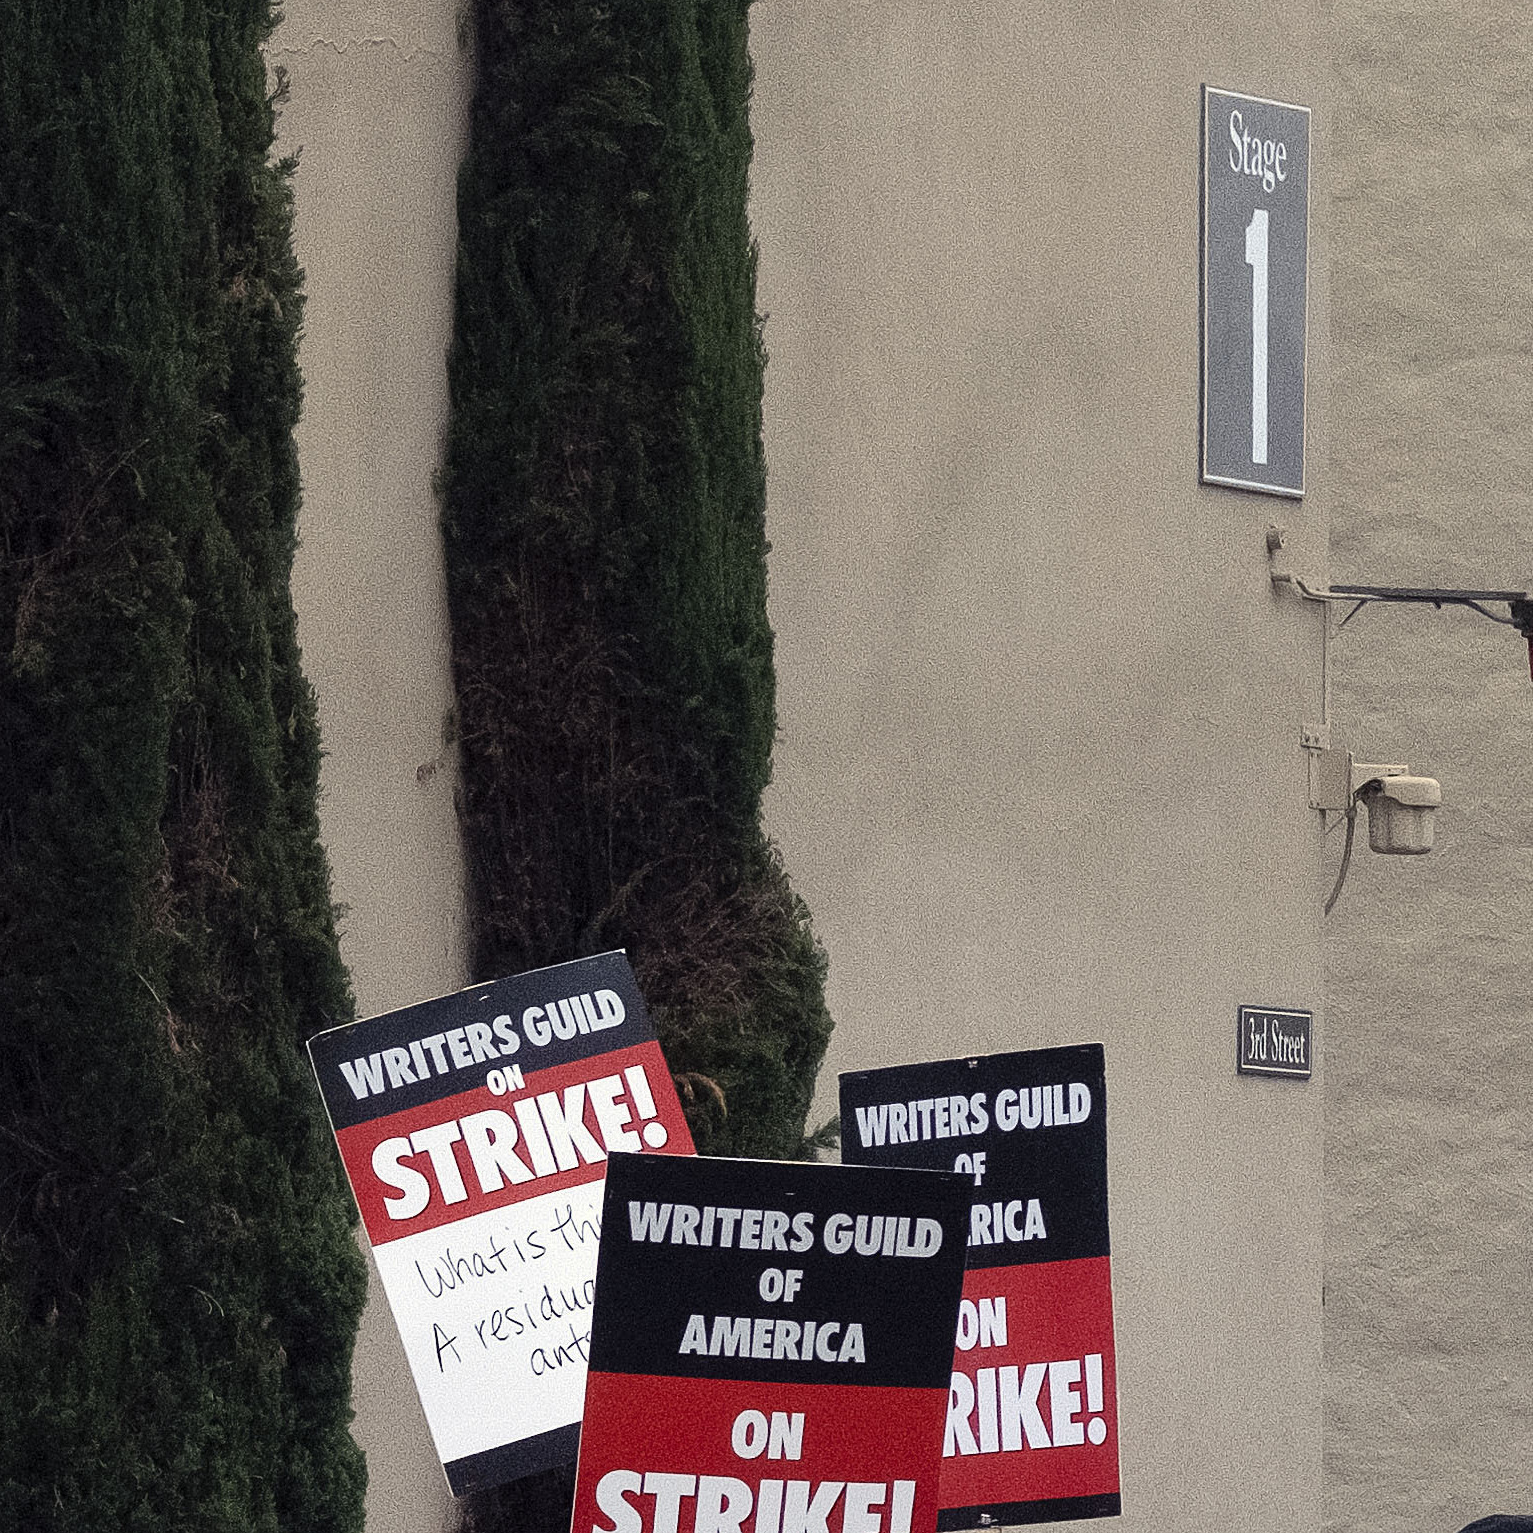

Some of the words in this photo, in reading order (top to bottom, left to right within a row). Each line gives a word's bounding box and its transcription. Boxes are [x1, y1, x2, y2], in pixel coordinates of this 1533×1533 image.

[1228, 109, 1288, 193] Stage
[1244, 208, 1272, 464] 1
[339, 1013, 519, 1101] WRITERS
[524, 988, 627, 1046] GUILD
[1247, 1016, 1267, 1060] 3rd
[1271, 1019, 1305, 1064] Street
[486, 1064, 526, 1097] ON
[370, 1063, 670, 1222] STRIKE!
[855, 1094, 989, 1149] WRITERS
[994, 1081, 1093, 1130] GUILD
[954, 1151, 986, 1186] OF
[628, 1200, 815, 1253] WRITERS
[824, 1213, 943, 1259] GUILD
[967, 1198, 1047, 1246] RICA
[414, 1236, 508, 1298] What
[505, 1226, 547, 1263] is
[758, 1268, 804, 1303] OF
[433, 1323, 462, 1373] A
[475, 1279, 595, 1349] residua
[678, 1314, 866, 1364] AMERICA
[955, 1296, 1008, 1351] ON
[730, 1409, 805, 1461] ON
[942, 1353, 1107, 1458] RIKE!
